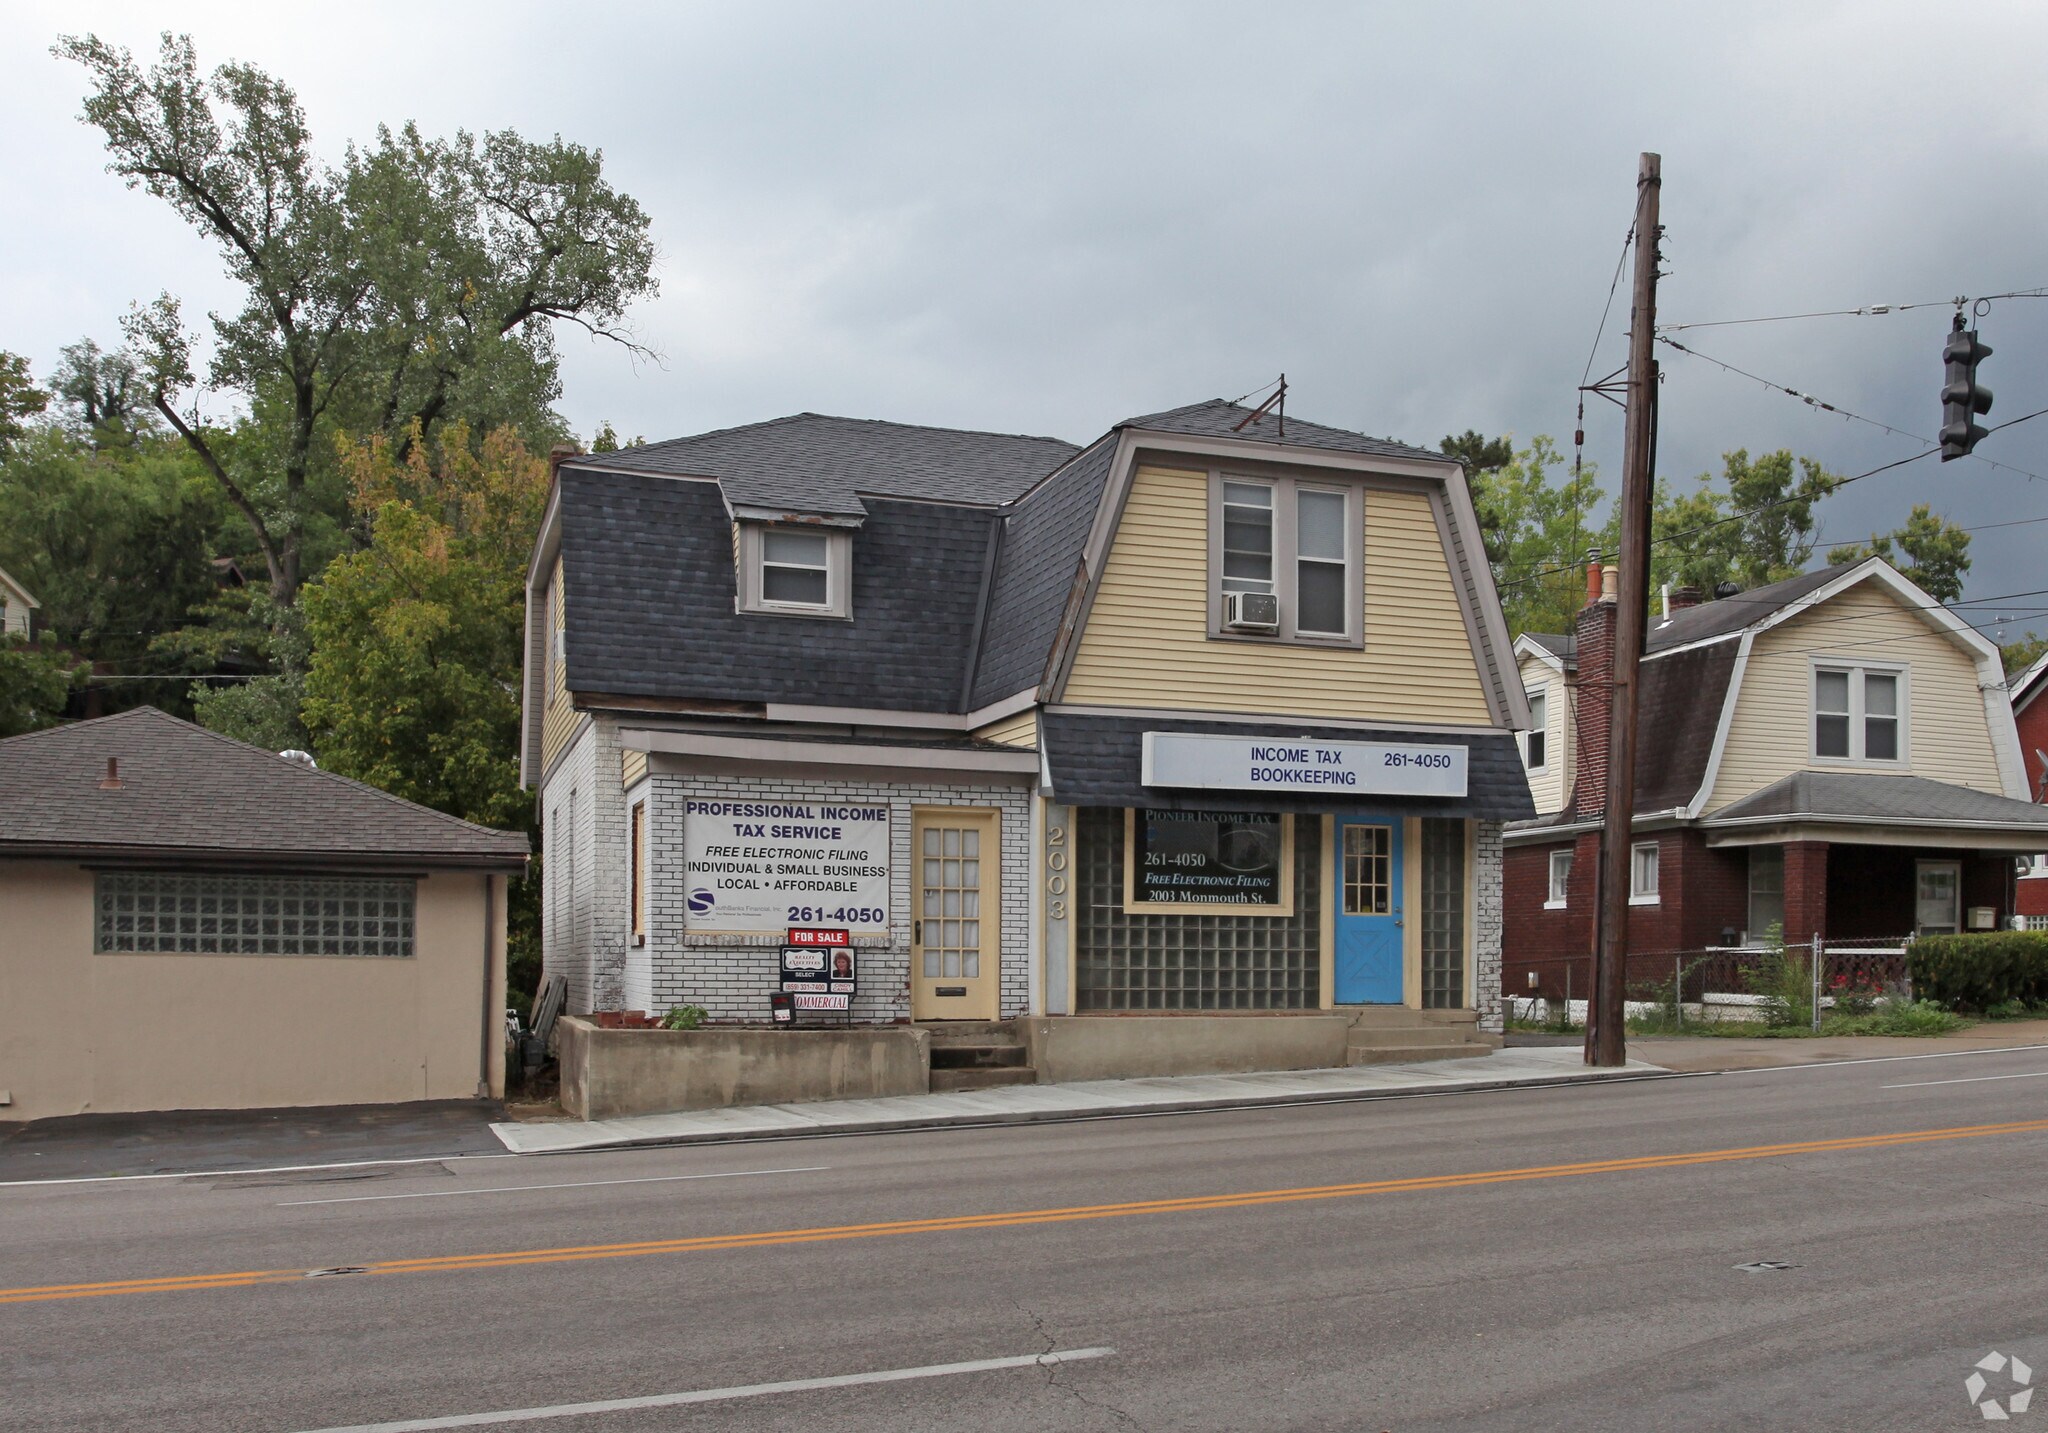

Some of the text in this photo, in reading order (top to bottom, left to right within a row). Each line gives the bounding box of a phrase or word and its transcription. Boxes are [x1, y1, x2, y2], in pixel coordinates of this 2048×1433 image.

[1251, 747, 1342, 764] INCOME TAX
[1384, 752, 1451, 768] 261-4050
[1251, 768, 1356, 785] BOOKKEEPING
[686, 801, 886, 821] PROFESSIONAL INCOME
[1249, 813, 1271, 825] TAX
[733, 823, 841, 839] TAX SERVICE
[705, 846, 869, 861] FREE ELECTRONIC FILING
[1144, 852, 1206, 867] 261-4050
[688, 861, 886, 877] INDIVIDUAL & SMALL BUSINESS
[1048, 826, 1066, 920] 2003
[717, 878, 858, 892] LOCAL AFFORDABLE
[1144, 872, 1271, 887] FREE ELECTRONIC FILING
[1149, 890, 1266, 904] 2003 Monmouth St.
[787, 906, 884, 923] 261-4050
[794, 932, 843, 942] FOR SALE
[794, 995, 847, 1009] OMMERCIAL
